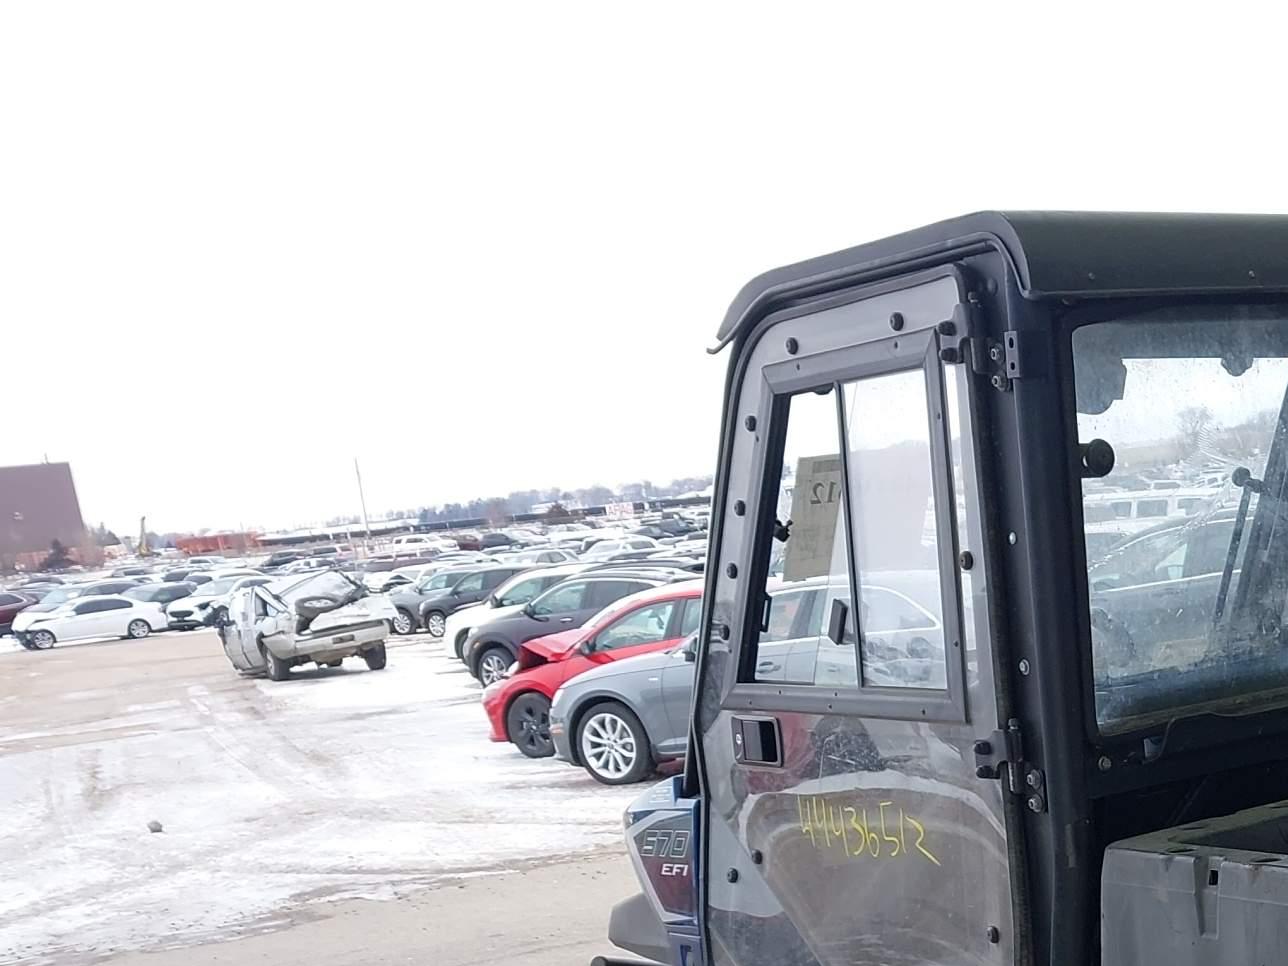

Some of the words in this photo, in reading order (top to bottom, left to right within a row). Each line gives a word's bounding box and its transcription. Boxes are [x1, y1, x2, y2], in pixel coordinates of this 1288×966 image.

[640, 829, 690, 858] 570
[798, 796, 941, 866] 44436512
[661, 863, 689, 876] EFI
